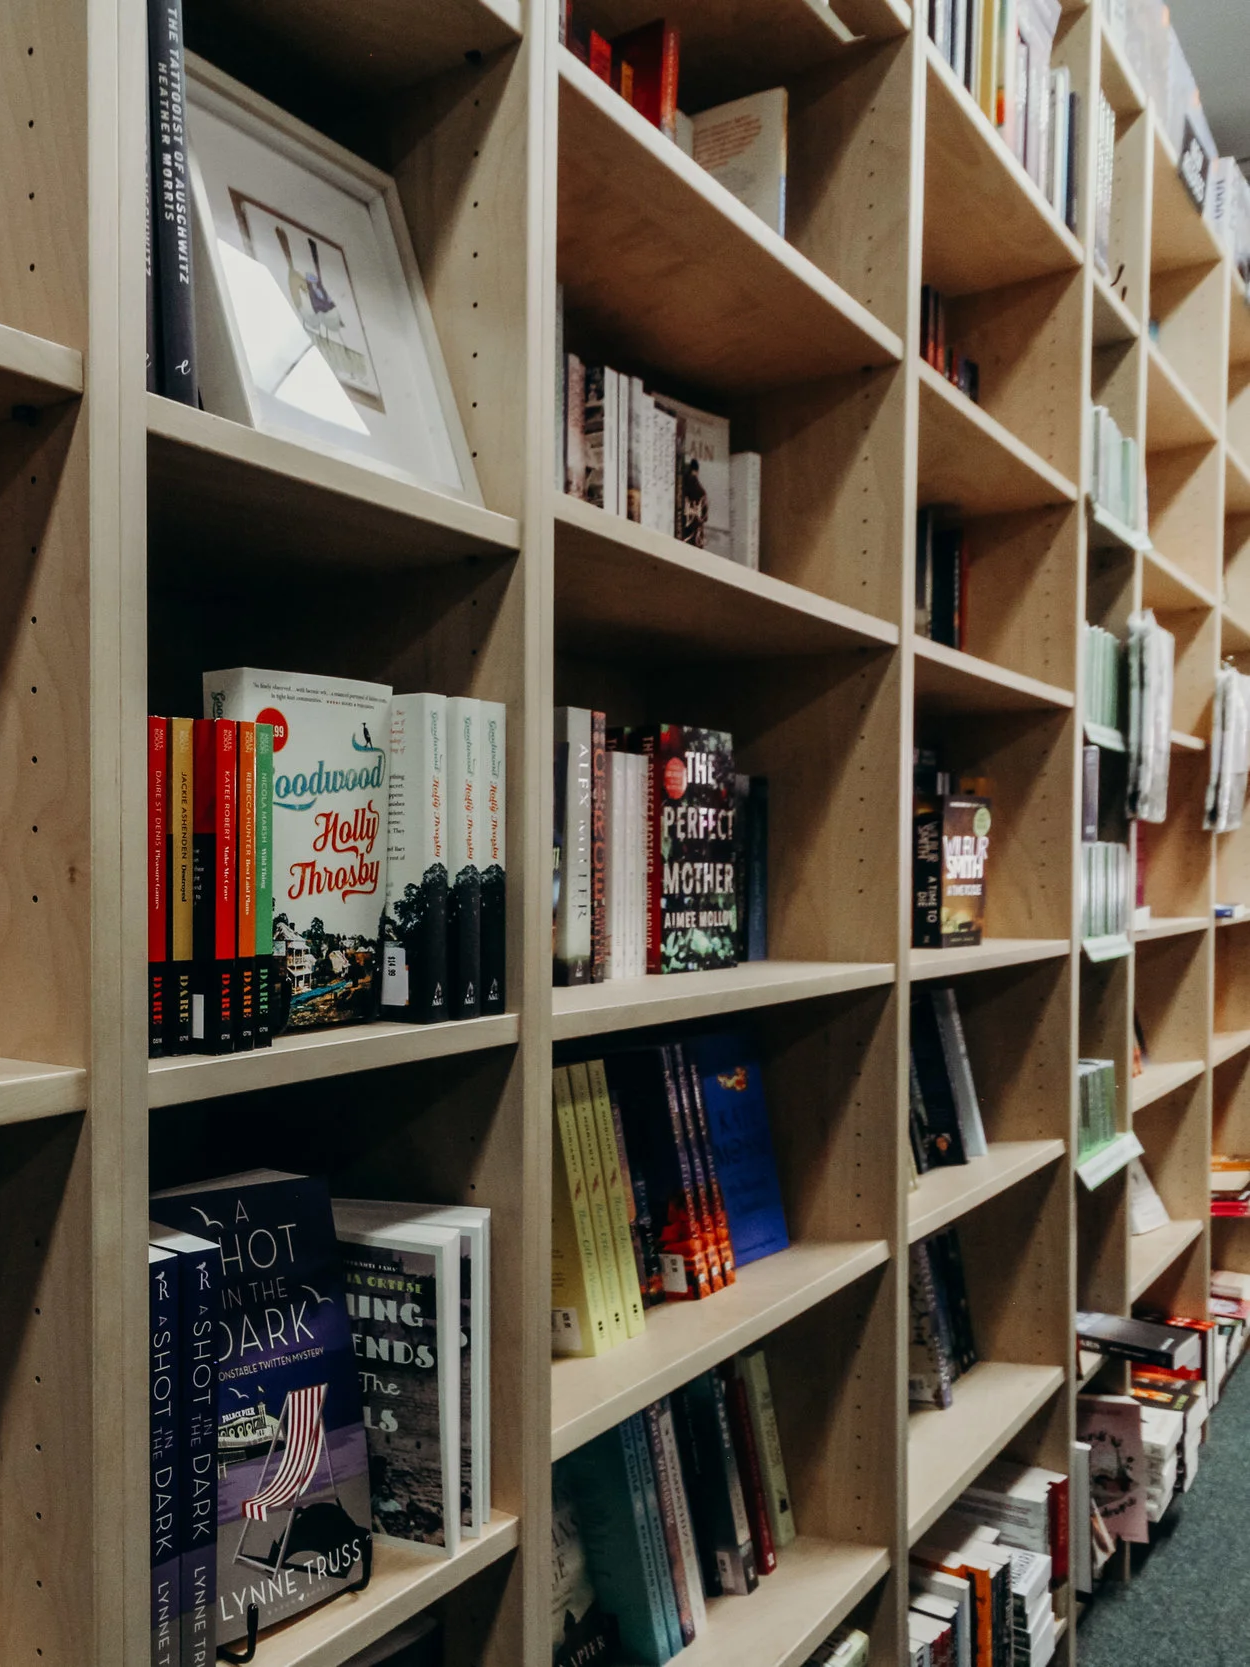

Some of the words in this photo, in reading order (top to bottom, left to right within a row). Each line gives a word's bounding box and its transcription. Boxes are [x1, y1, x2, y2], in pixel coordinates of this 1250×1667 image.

[167, 7, 179, 41] THE
[158, 62, 171, 145] HEATHER
[169, 49, 185, 148] TATTOOIST
[173, 151, 185, 173] OF
[162, 153, 176, 221] MORRIS
[174, 174, 189, 286] AUSCHWITZ
[273, 755, 384, 804] oodwood
[577, 743, 590, 808] ALEX
[684, 750, 718, 790] THE
[154, 801, 162, 814] ST
[223, 803, 231, 841] ROBERT
[312, 799, 381, 858] Holly
[662, 806, 736, 843] PERFECT
[154, 817, 162, 847] DENIS
[180, 808, 188, 860] ASHENDEN
[180, 864, 188, 903] Destroyed
[288, 853, 381, 904] Throsby
[662, 861, 735, 896] MOTHER
[663, 911, 697, 929] AIMEE
[699, 909, 734, 928] MOLLOY
[152, 975, 163, 1025] DARE
[179, 975, 189, 1023] DARE
[220, 973, 231, 1021] DARE
[242, 970, 253, 1019] DARE
[259, 968, 269, 1015] DARE
[235, 1199, 250, 1224] A
[218, 1223, 297, 1277] HOT
[221, 1286, 242, 1310] IN
[248, 1276, 288, 1303] THE
[366, 1274, 423, 1295] ORTESE
[157, 1315, 168, 1328] A
[198, 1304, 210, 1316] A
[192, 1320, 213, 1406] SHOT
[218, 1364, 259, 1383] ONSTABLE
[258, 1356, 293, 1374] TWITTEN
[291, 1346, 324, 1366] MYSTERY
[351, 1332, 436, 1369] ENDS
[153, 1330, 172, 1417] SHOT
[357, 1371, 401, 1396] The
[152, 1426, 163, 1462] THE
[163, 1429, 174, 1450] IN
[190, 1413, 203, 1449] THE
[202, 1417, 214, 1437] IN
[154, 1465, 174, 1557] DARK
[191, 1453, 212, 1541] DARK
[193, 1565, 207, 1634] LYNNE
[220, 1568, 298, 1622] LYNNE
[303, 1538, 363, 1586] TRUSS
[156, 1581, 171, 1651] LYNNE
